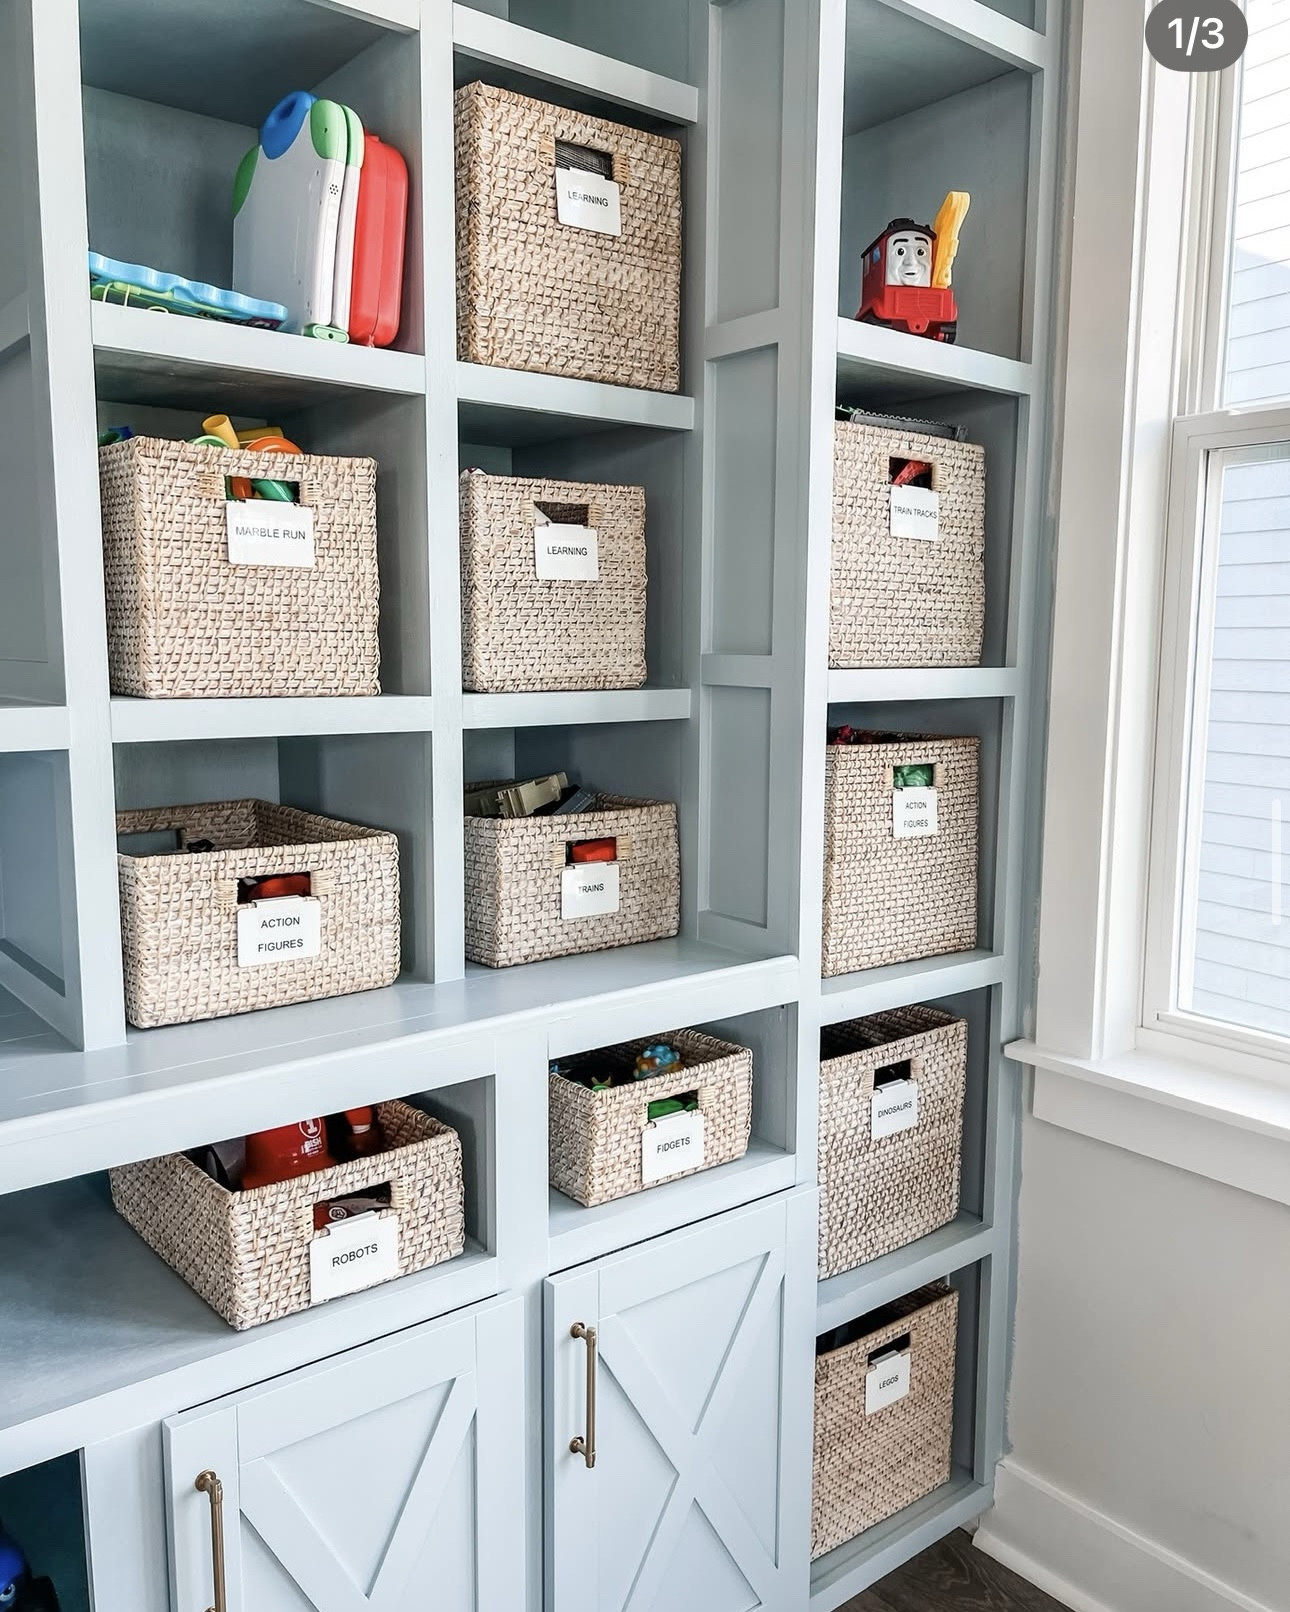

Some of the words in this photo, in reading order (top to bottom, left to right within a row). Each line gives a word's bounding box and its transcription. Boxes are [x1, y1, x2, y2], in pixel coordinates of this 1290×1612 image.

[567, 190, 609, 208] LEARNING
[893, 503, 913, 515] TRAIN
[914, 506, 938, 519] TRACKS
[235, 525, 280, 540] MARBLE
[282, 530, 306, 541] RUN
[546, 545, 589, 558] LEARNING
[904, 801, 928, 811] ACTION
[903, 818, 929, 829] FIGURES
[578, 883, 605, 894] TRAINS
[260, 916, 302, 929] ACTION
[257, 937, 304, 953] FIGURES
[877, 1101, 913, 1119] DINOSAURS
[656, 1136, 691, 1155] FIDGETS
[331, 1242, 379, 1268] ROBOTS
[878, 1374, 899, 1390] LEGOS
